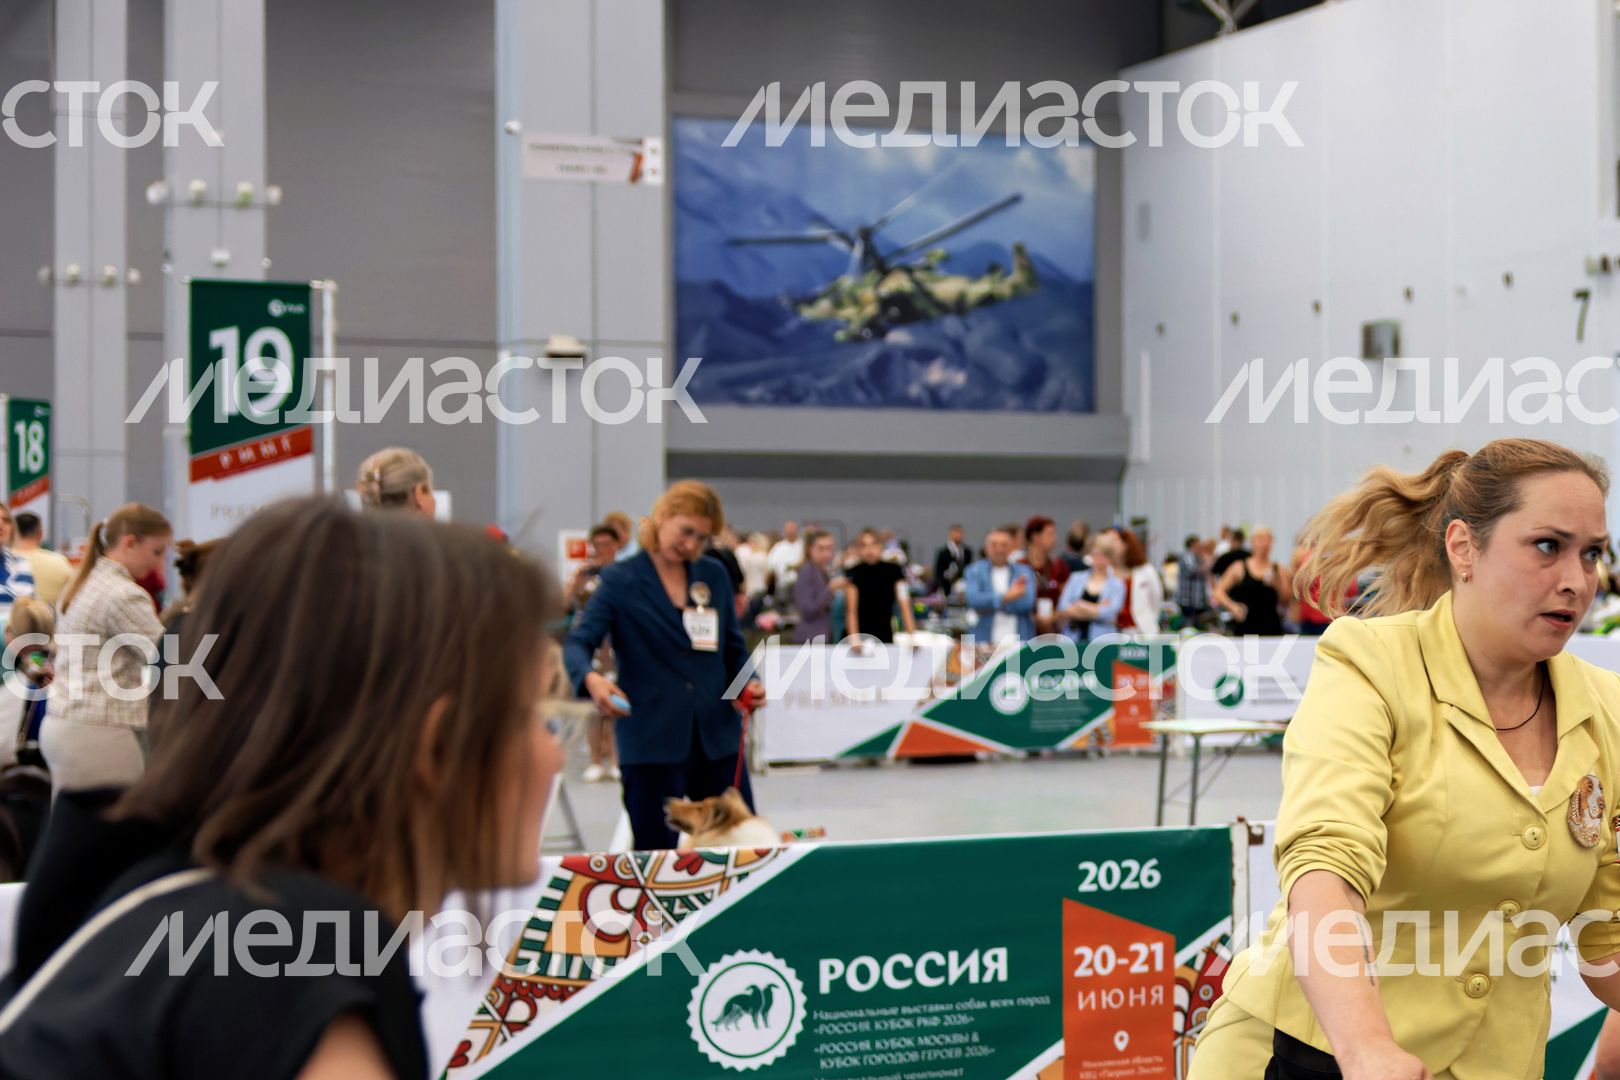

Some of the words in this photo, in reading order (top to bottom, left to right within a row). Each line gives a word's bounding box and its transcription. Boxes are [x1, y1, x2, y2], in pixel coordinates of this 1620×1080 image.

[1572, 289, 1591, 343] 7
[208, 325, 295, 418] 19
[14, 420, 45, 474] 18
[1077, 858, 1162, 892] 2026
[819, 947, 1008, 994] РОССИЯ
[1073, 941, 1164, 977] 20-21
[1078, 985, 1164, 1011] ИЮНЯ
